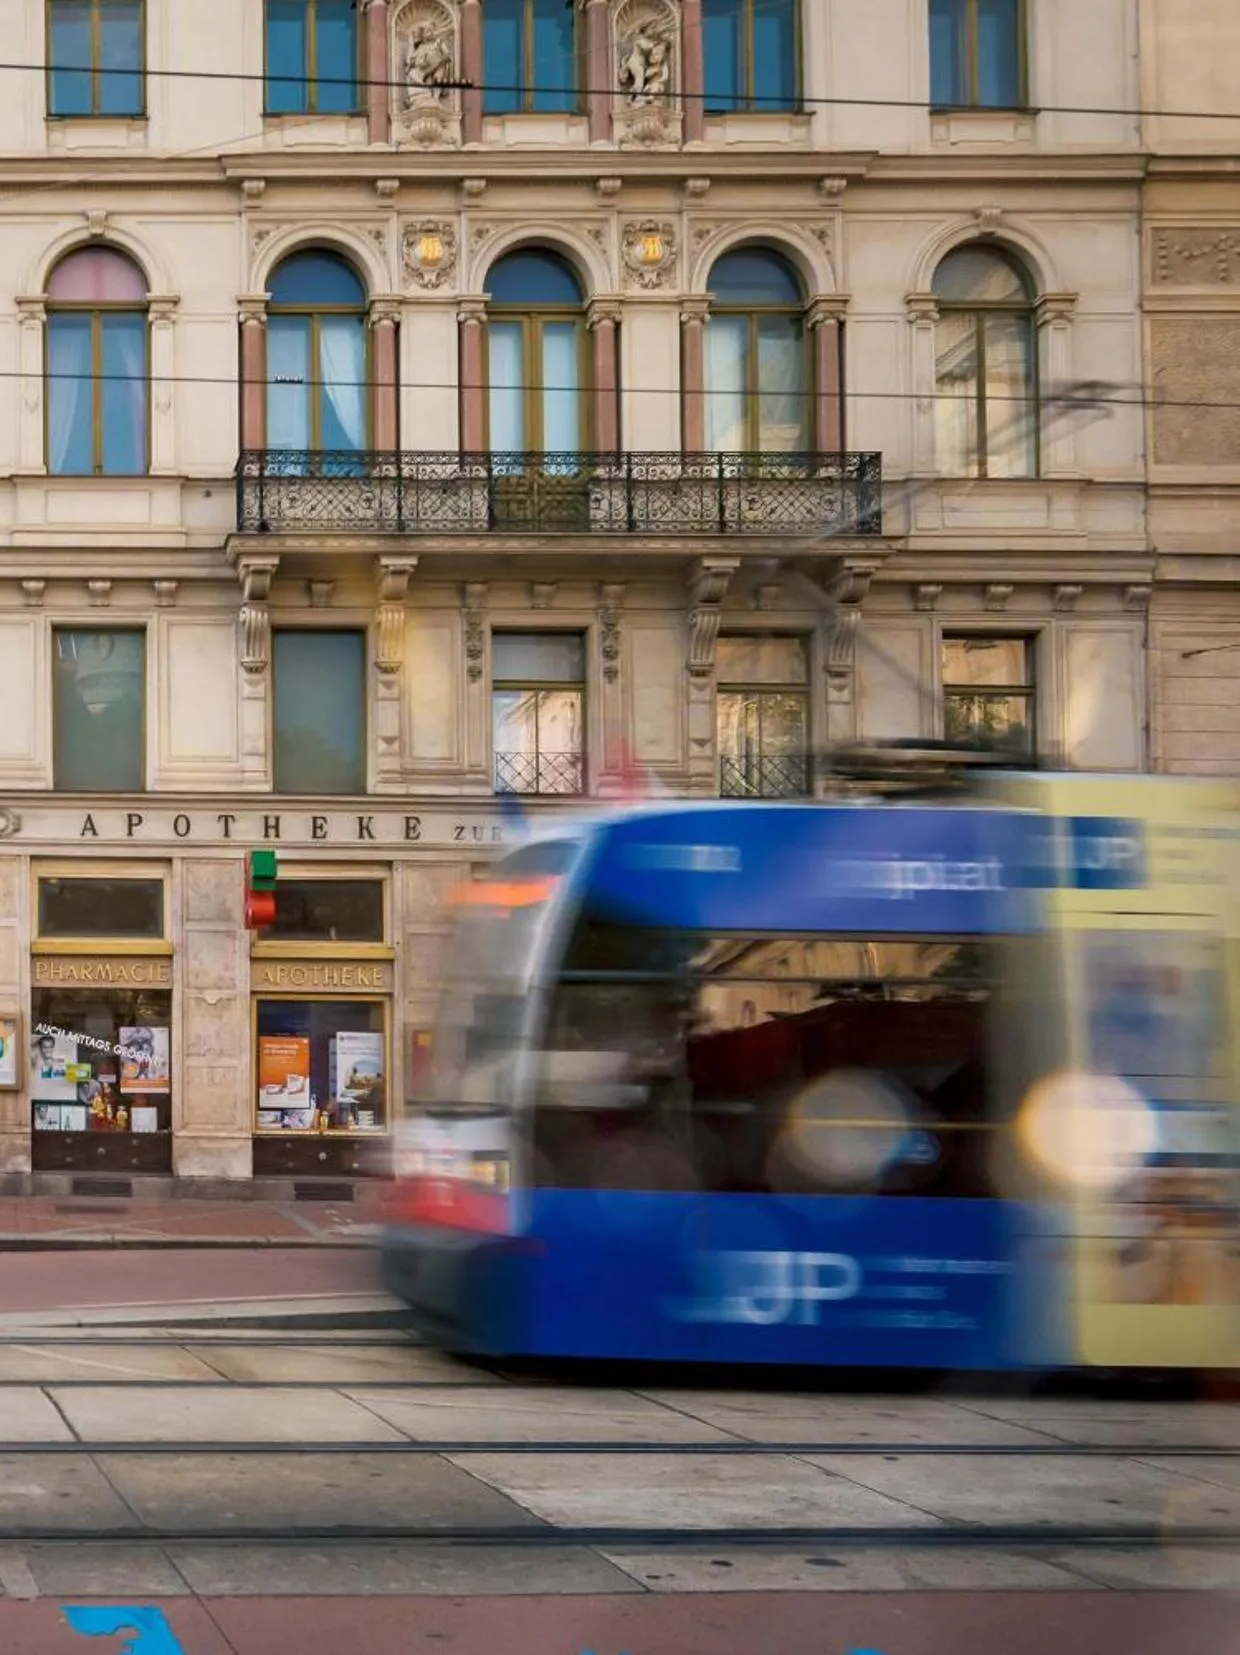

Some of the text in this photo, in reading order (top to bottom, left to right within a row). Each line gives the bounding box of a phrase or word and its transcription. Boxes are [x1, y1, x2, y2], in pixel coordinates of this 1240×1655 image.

[80, 813, 421, 841] APOTHEKE
[35, 960, 170, 982] PHARMACIE
[263, 964, 384, 987] APOTHEKE
[35, 1022, 67, 1040] AUCH
[68, 1030, 110, 1052] MITTAGS
